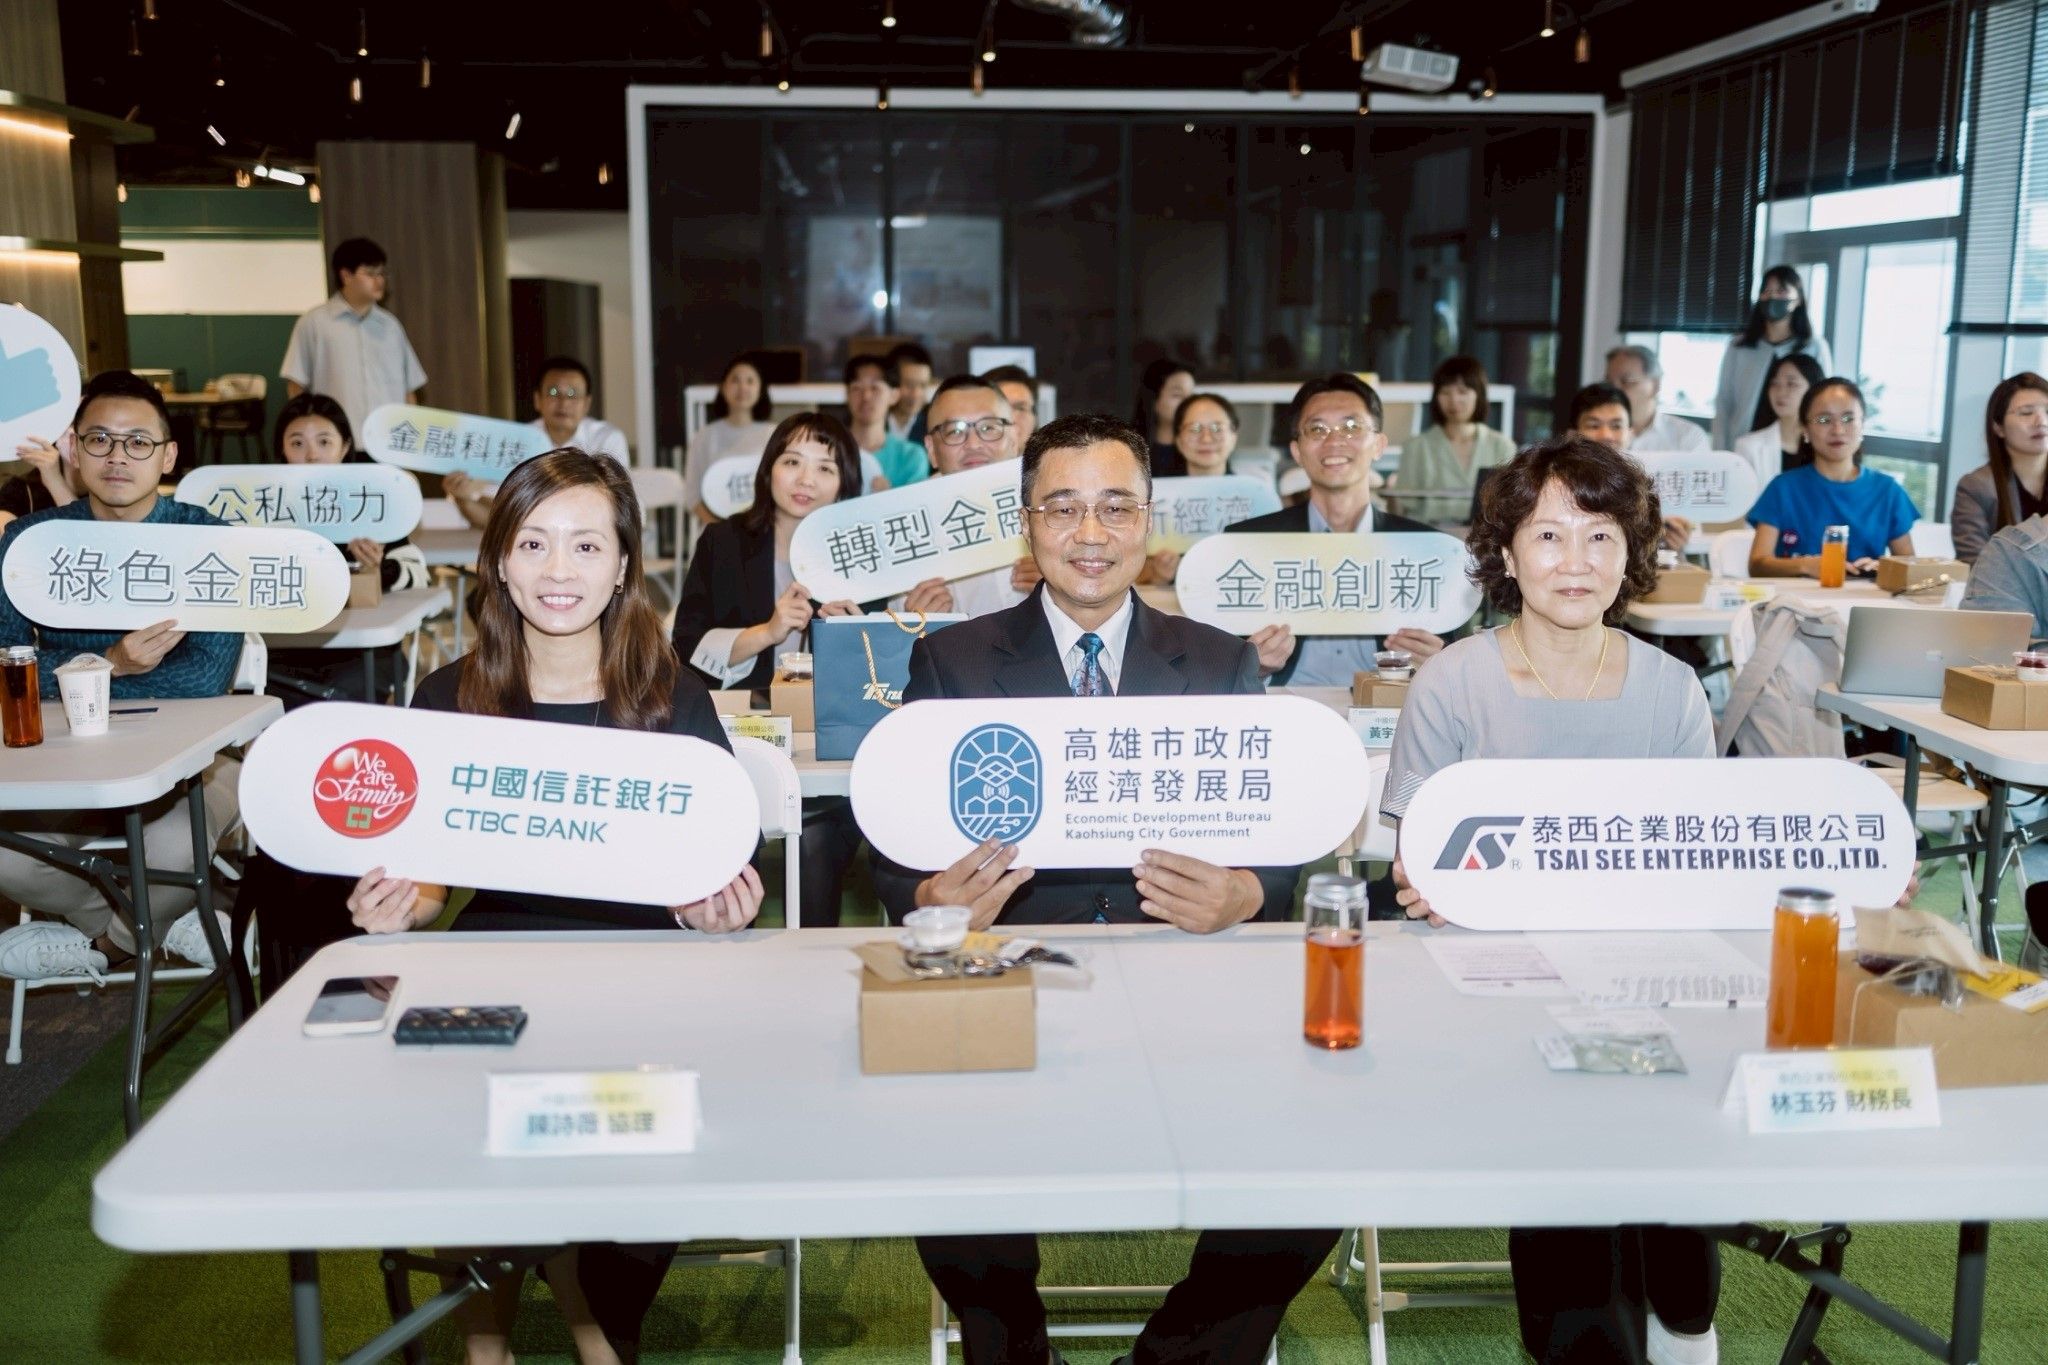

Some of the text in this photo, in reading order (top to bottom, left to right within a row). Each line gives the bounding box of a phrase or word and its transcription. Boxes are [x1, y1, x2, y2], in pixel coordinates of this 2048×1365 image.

[208, 485, 386, 524] 公私協力
[48, 546, 304, 607] 綠色金融
[1215, 558, 1442, 609] 金融創新
[1064, 725, 1272, 762] 高雄市政府
[353, 751, 387, 772] We
[315, 769, 418, 820] Family
[363, 770, 395, 789] are
[451, 763, 693, 815] 中國信託銀行
[1064, 768, 1272, 803] 經濟發展局
[445, 807, 608, 843] CTBC BANK
[1065, 811, 1272, 826] Economic Development Bureau
[1065, 827, 1250, 841] Kaohsiung City Government
[1532, 813, 1886, 844] 泰西企業股份有限公司
[1534, 847, 1888, 871] TSAI SEE ENTERPRISE CO.,LTD.
[1770, 1091, 1837, 1115] 林玉芬
